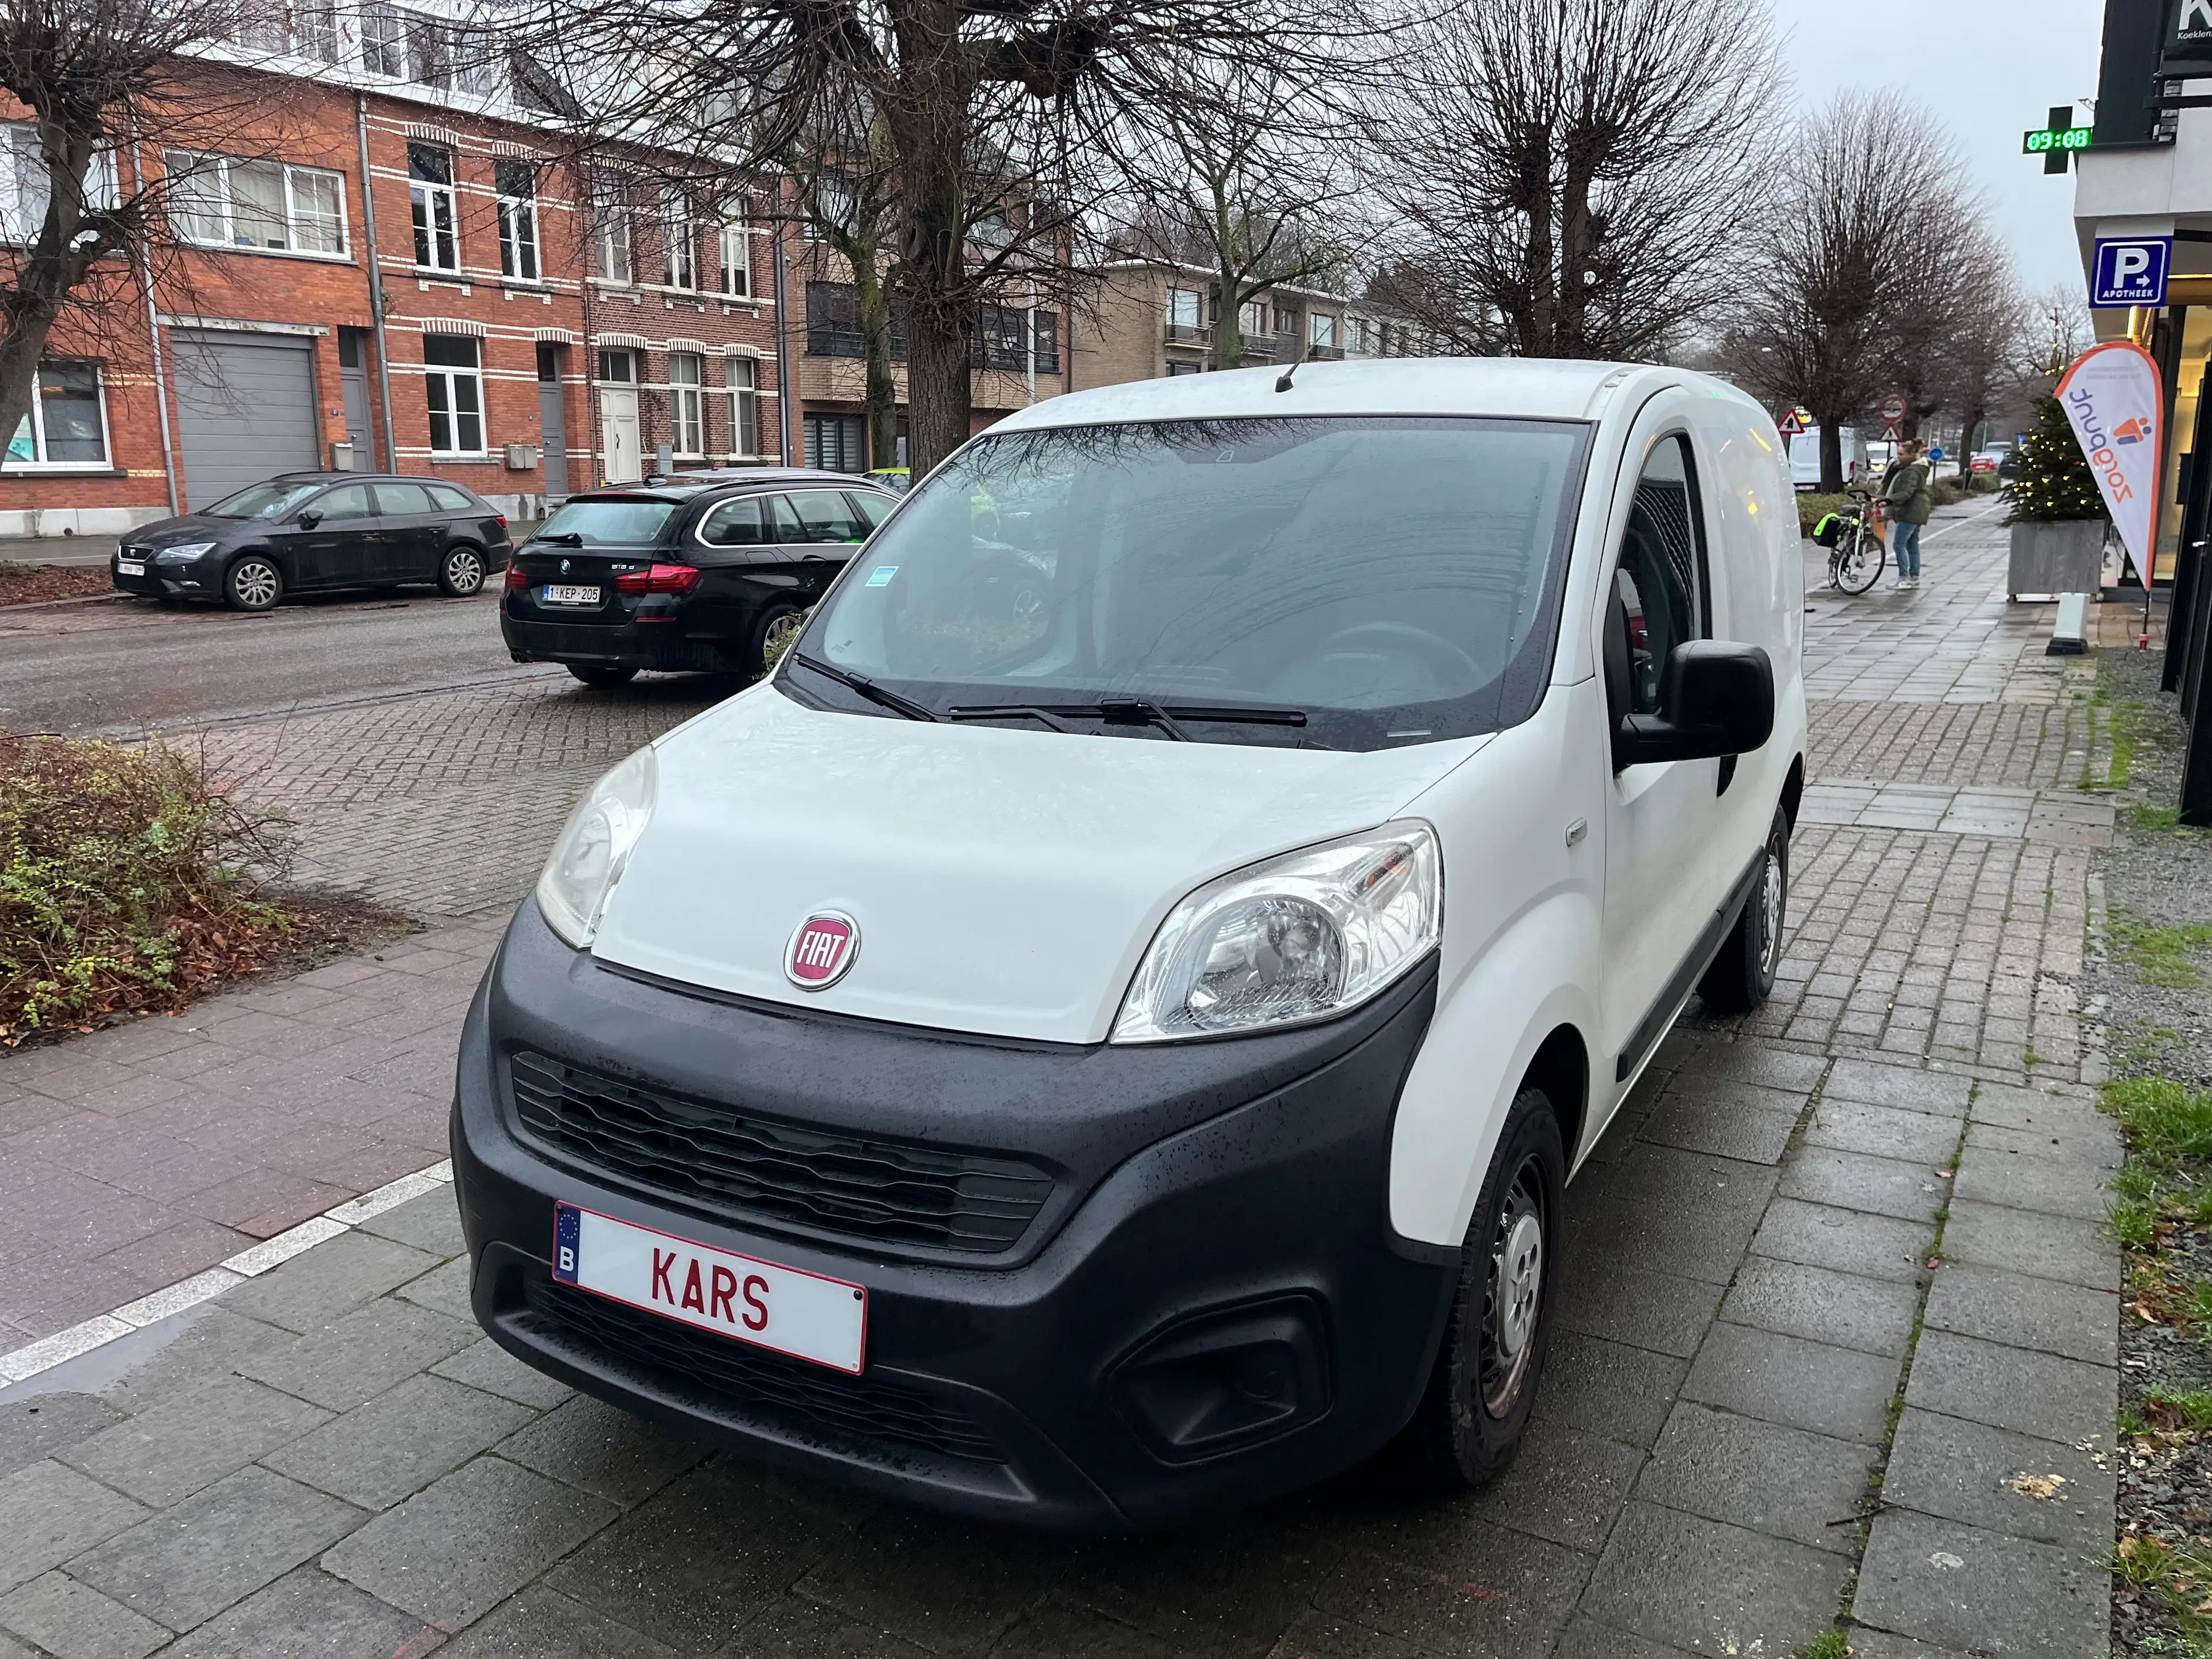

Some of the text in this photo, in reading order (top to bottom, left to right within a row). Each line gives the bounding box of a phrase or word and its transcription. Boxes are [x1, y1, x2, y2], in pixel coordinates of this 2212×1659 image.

[2177, 30, 2212, 40] Koeklen
[2027, 130, 2089, 150] 09:08
[2113, 248, 2149, 289] P
[2102, 289, 2154, 298] APOTHEEK
[796, 930, 846, 968] FIAT
[559, 1245, 574, 1272] B
[652, 1248, 770, 1332] KARS
